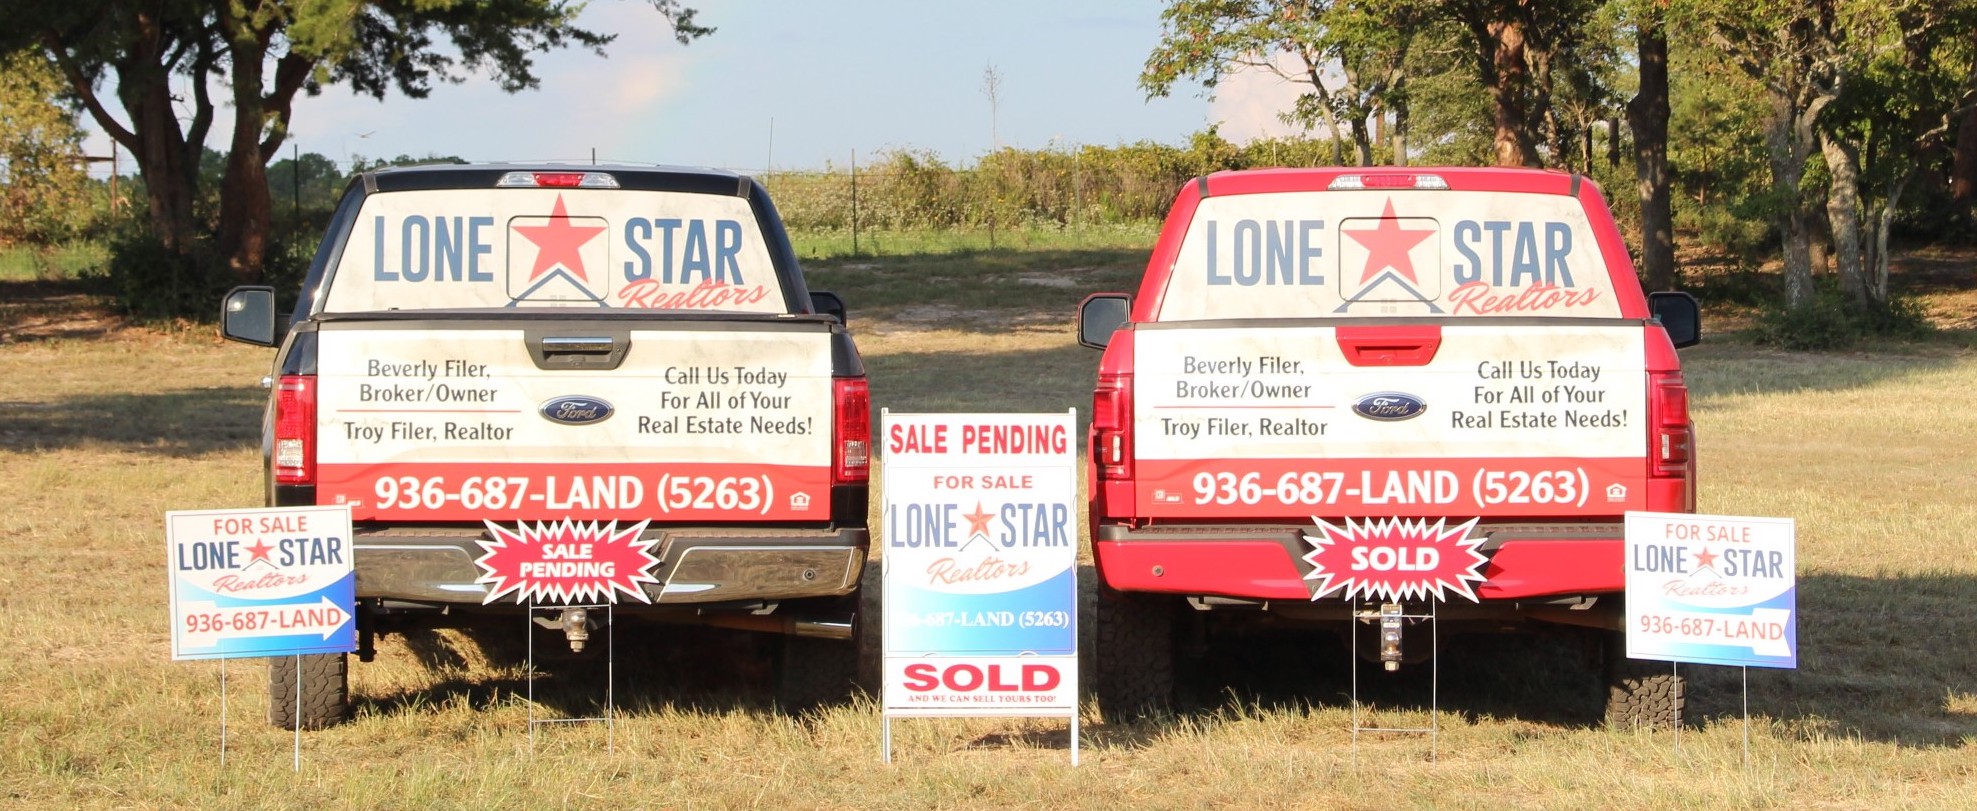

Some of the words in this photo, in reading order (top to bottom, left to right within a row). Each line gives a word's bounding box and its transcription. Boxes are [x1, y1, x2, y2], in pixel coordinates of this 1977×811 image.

[374, 215, 494, 283] LONE
[624, 216, 745, 286] STAR
[1206, 219, 1325, 287] LONE
[1453, 219, 1575, 288] STAR
[618, 277, 771, 310] Realtors
[1448, 280, 1602, 316] Realtors
[368, 359, 438, 381] Beverly
[445, 359, 491, 378] Filer,
[664, 366, 699, 384] Call
[707, 367, 729, 384] Us
[734, 366, 787, 388] Today
[1184, 356, 1252, 378] Beverly
[1260, 356, 1304, 376] Filer,
[1477, 361, 1512, 379] Call
[1520, 361, 1543, 379] Us
[1547, 361, 1600, 383] Today
[360, 383, 497, 402] Broker/Owner
[661, 391, 690, 409] For
[696, 391, 720, 409] All
[728, 391, 746, 409] of
[750, 391, 791, 409] Your
[1176, 380, 1311, 399] Broker/Owner
[1474, 386, 1504, 404] For
[1510, 386, 1534, 403] All
[1542, 385, 1560, 403] of
[1564, 385, 1605, 403] Your
[556, 400, 598, 420] Ford
[1368, 397, 1410, 418] Ford
[1452, 410, 1492, 428] Real
[1500, 410, 1557, 428] Estate
[1565, 409, 1627, 428] Needs!
[344, 421, 384, 444] Troy
[391, 421, 437, 442] Filer,
[445, 422, 514, 440] Realtor
[638, 415, 678, 434] Real
[687, 415, 743, 434] Estate
[750, 415, 812, 435] Needs!
[1161, 417, 1200, 440] Troy
[1208, 417, 1252, 438] Filer,
[1260, 417, 1328, 436] Realtor
[890, 424, 948, 454] SALE
[963, 424, 1067, 454] PENDING
[933, 475, 974, 489] FOR
[981, 475, 1033, 489] SALE
[1193, 469, 1459, 506] 936-687-LAND
[1472, 467, 1589, 510] (5263)
[374, 475, 644, 510] 936-687-LAND
[657, 472, 774, 515] (5263)
[213, 518, 254, 536] FOR
[259, 516, 308, 534] SALE
[891, 503, 958, 548] LONE
[1000, 502, 1069, 548] STAR
[1666, 523, 1701, 541] FOR
[1707, 525, 1751, 543] SALE
[178, 541, 241, 571] LONE
[279, 537, 343, 567] STAR
[542, 543, 594, 560] SALE
[1351, 546, 1440, 571] SOLD
[1634, 543, 1688, 574] LONE
[1723, 548, 1784, 579] STAR
[519, 562, 615, 578] PENDING
[926, 556, 1032, 585] Realtors
[212, 571, 312, 593] Realtors
[1662, 579, 1749, 598] Realtors
[186, 607, 342, 633] 936-687-LAND
[1018, 610, 1070, 629] (5263)
[1640, 615, 1783, 641] 936-687-LAND
[903, 663, 1061, 692] SOLD
[908, 695, 929, 703] AND
[932, 695, 946, 703] WE
[950, 695, 970, 703] CAN
[973, 695, 996, 703] SELL
[999, 695, 1031, 703] YOURS
